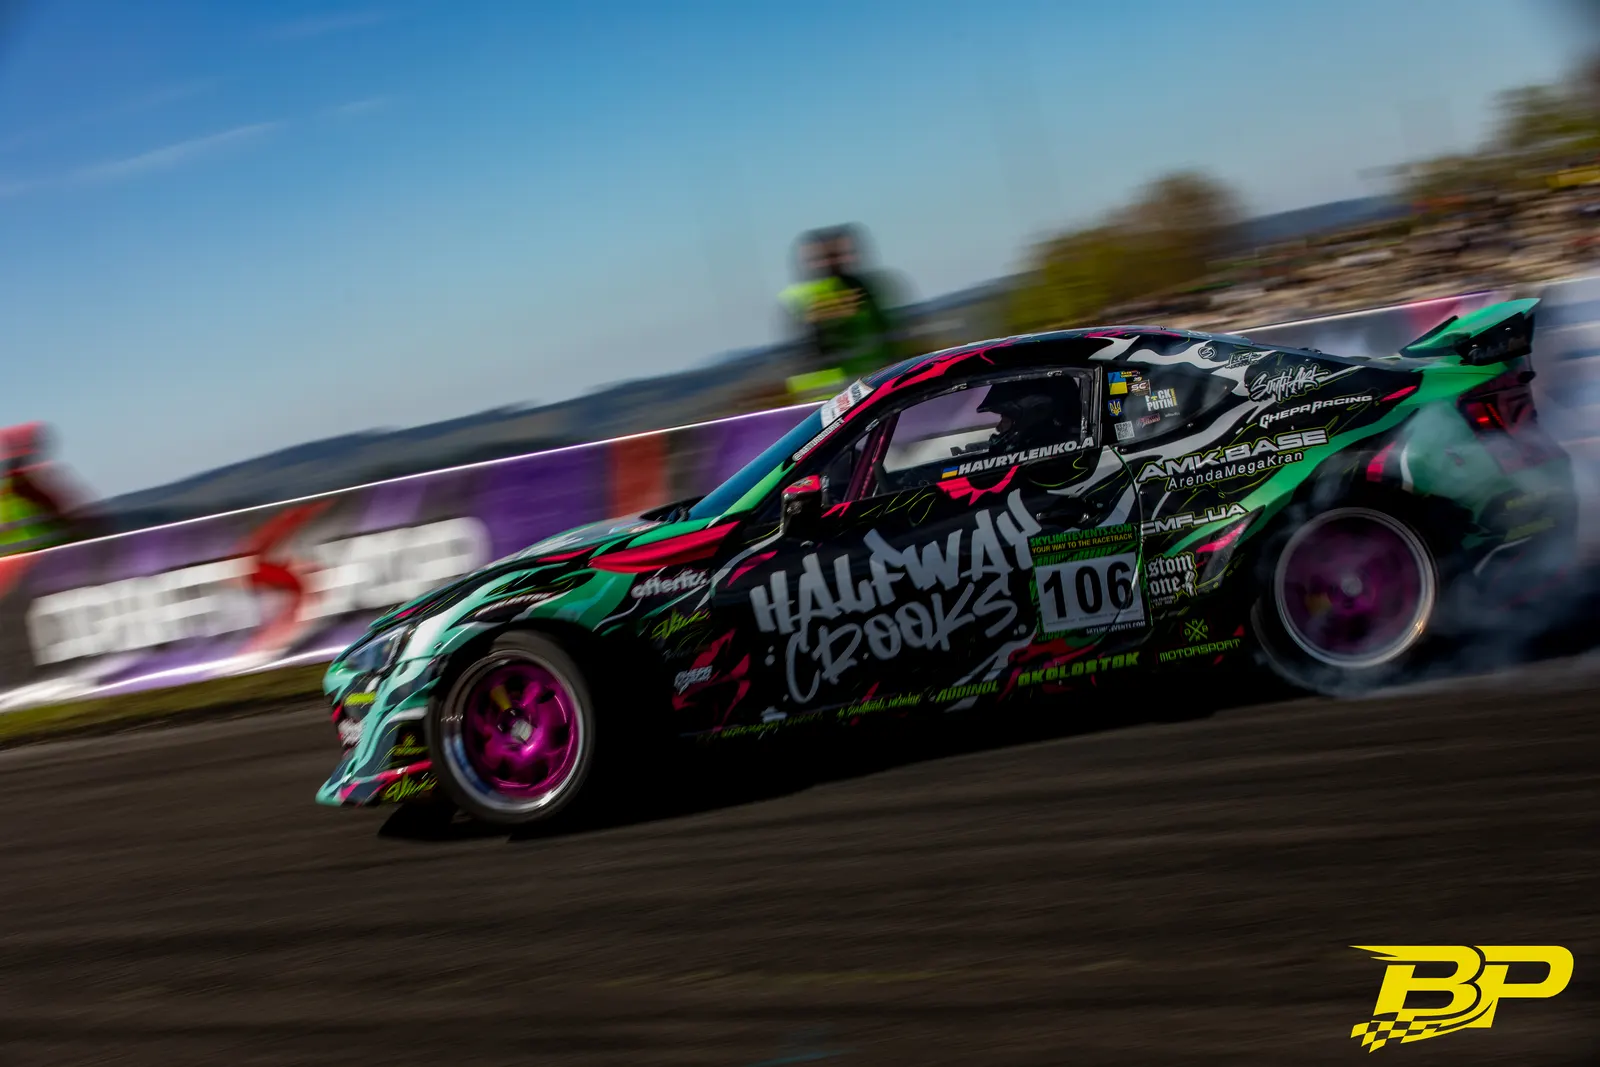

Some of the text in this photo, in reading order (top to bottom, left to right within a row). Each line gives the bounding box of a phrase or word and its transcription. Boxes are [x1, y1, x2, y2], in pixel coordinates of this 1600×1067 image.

[1147, 398, 1174, 412] PUTIN
[958, 436, 1094, 476] HAVRYLENKO.A
[1138, 430, 1328, 482] AMK.BASE
[1168, 452, 1304, 491] ArendaMegaKran
[1030, 523, 1133, 547] SKYLIMITEVENTS.COM
[1032, 532, 1133, 555] YOUR WAY TO THE RACETRACK
[749, 488, 1043, 645] HALFWAY
[1145, 555, 1194, 578] stom
[1043, 561, 1134, 619] 106
[785, 578, 1019, 704] CROOKS
[1159, 637, 1241, 663] MOTORSPORT
[935, 680, 1000, 704] ADDINOL
